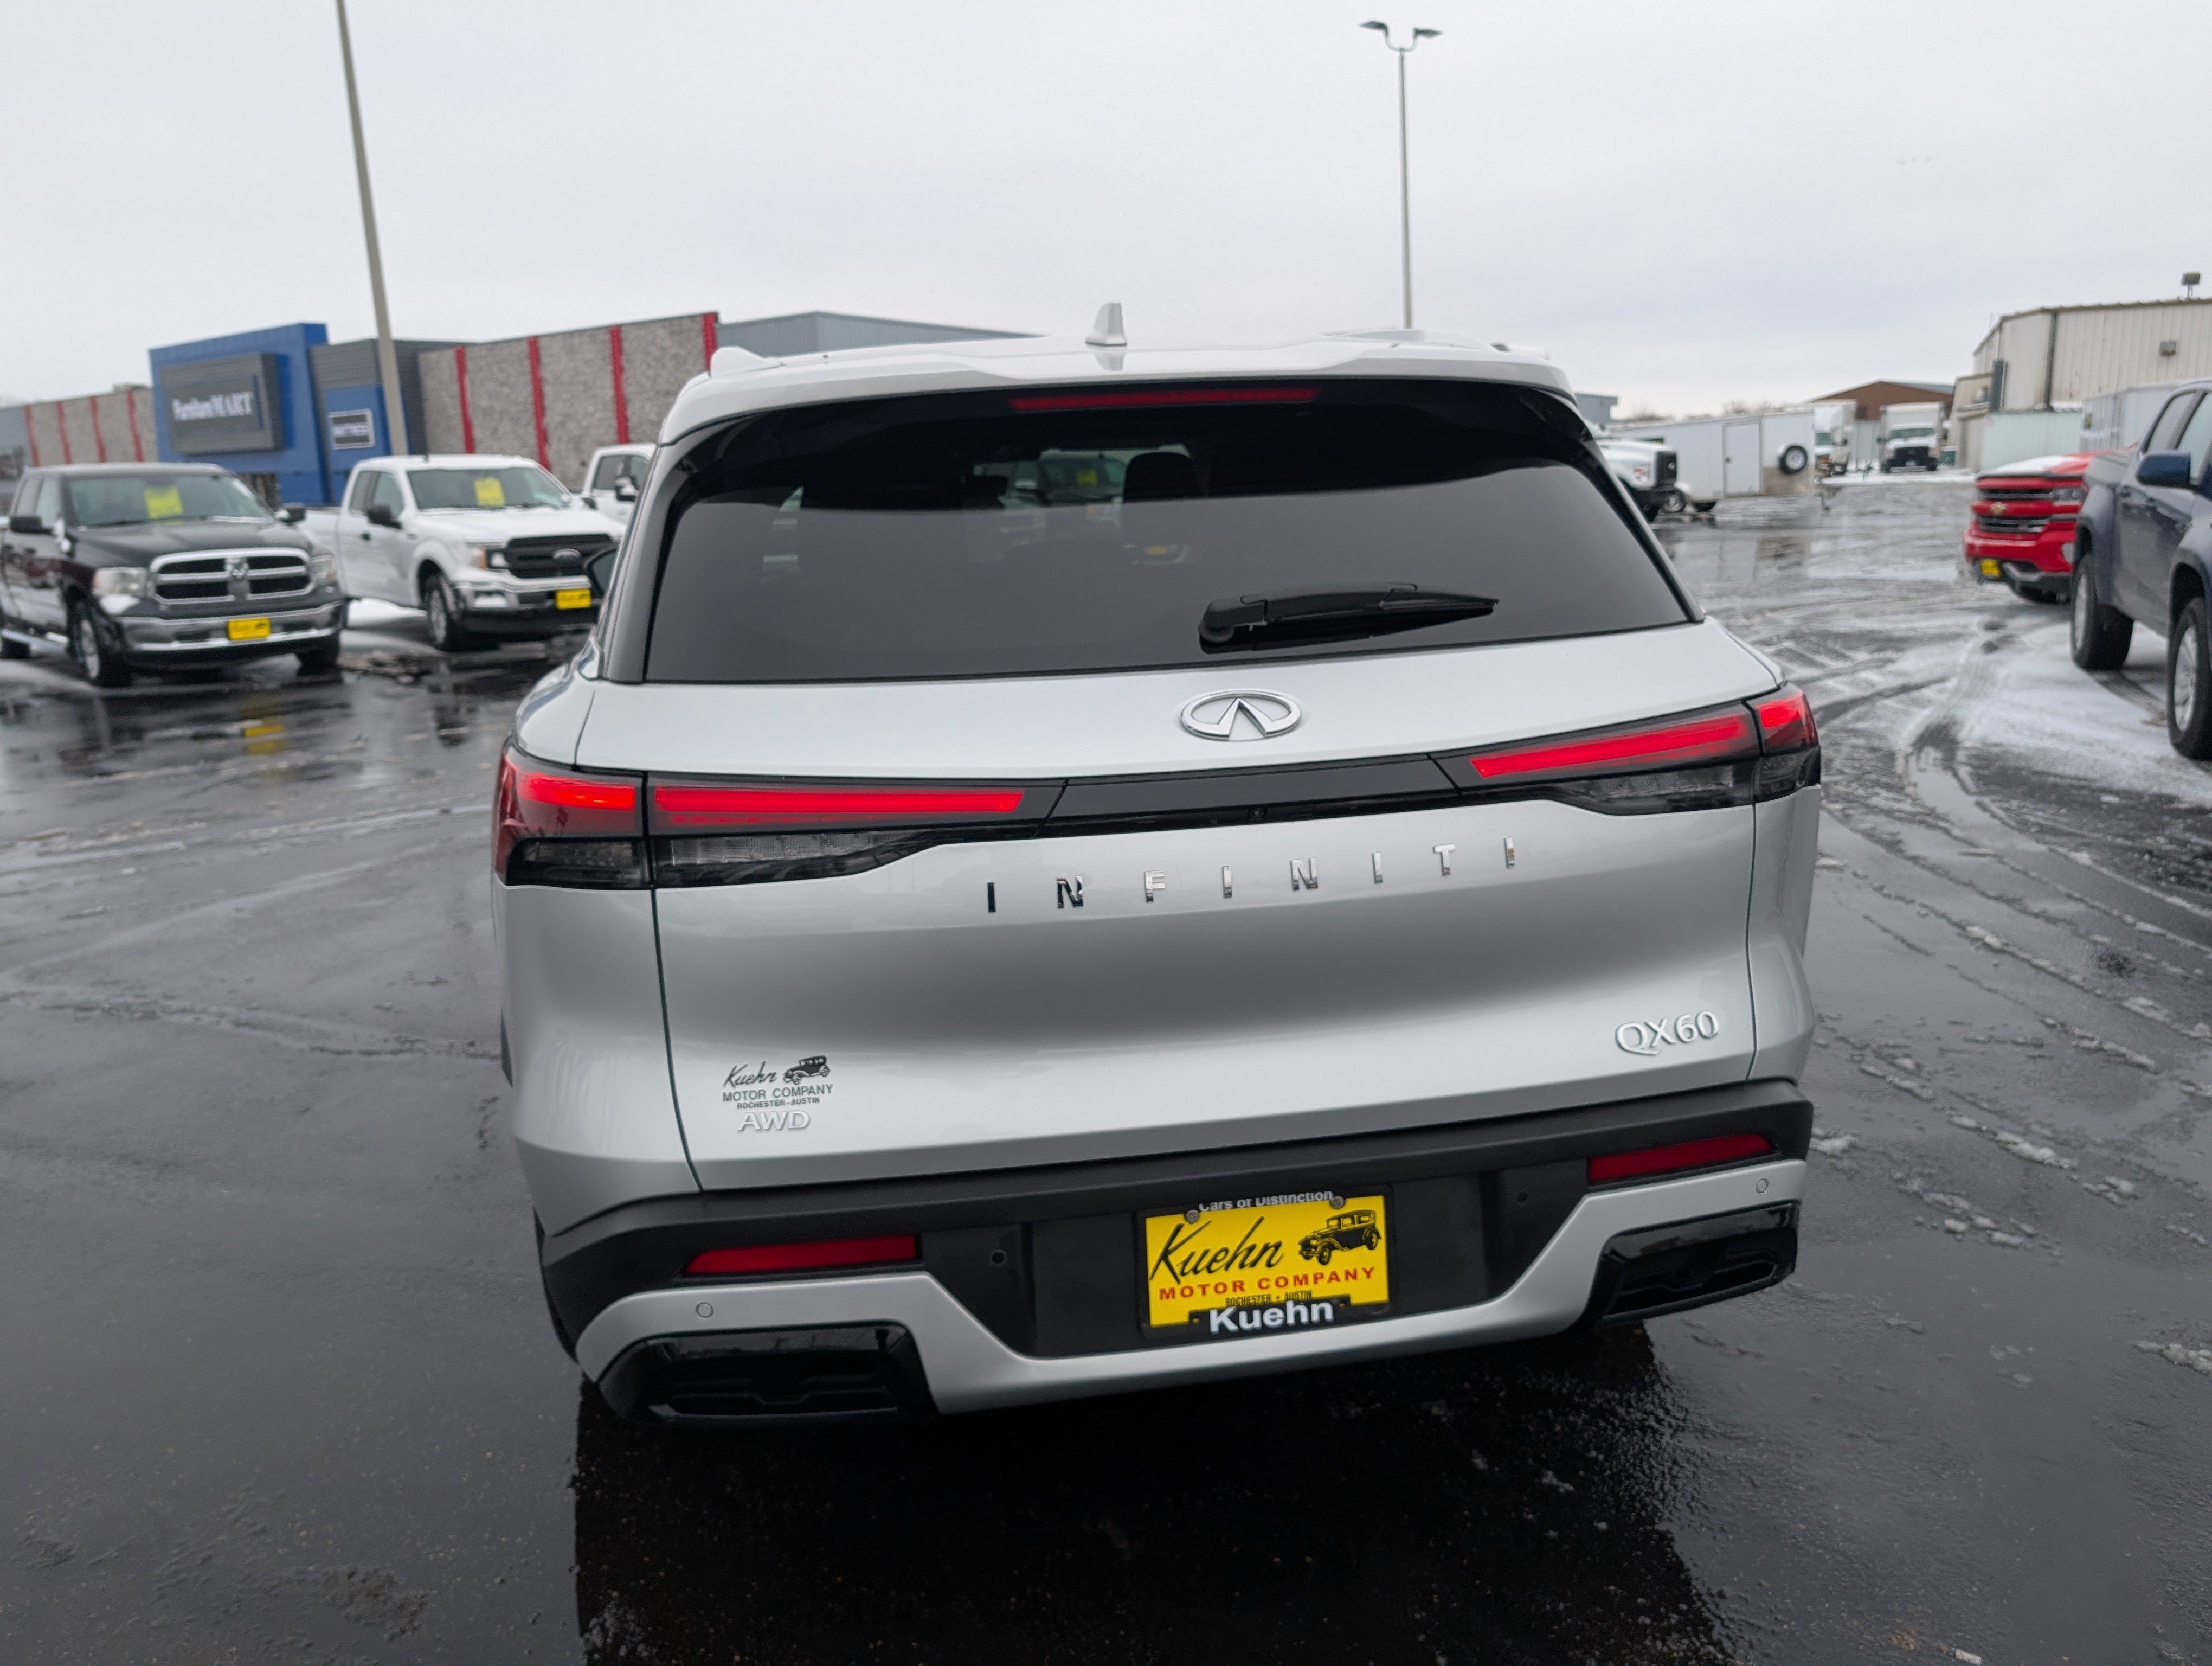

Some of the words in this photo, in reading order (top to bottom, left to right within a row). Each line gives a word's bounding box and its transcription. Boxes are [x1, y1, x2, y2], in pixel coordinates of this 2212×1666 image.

[986, 836, 1516, 913] INFINITI
[1615, 1010, 1718, 1056] QX60
[723, 1060, 777, 1088] Kuehn
[723, 1089, 766, 1102] MOTOR
[773, 1084, 833, 1098] COMPANY
[737, 1110, 811, 1132] AWD
[1149, 1216, 1284, 1284] Kuehn
[1159, 1279, 1245, 1300] MOTOR
[1257, 1266, 1375, 1290] COMPANY
[1209, 1300, 1335, 1335] Kuehn
